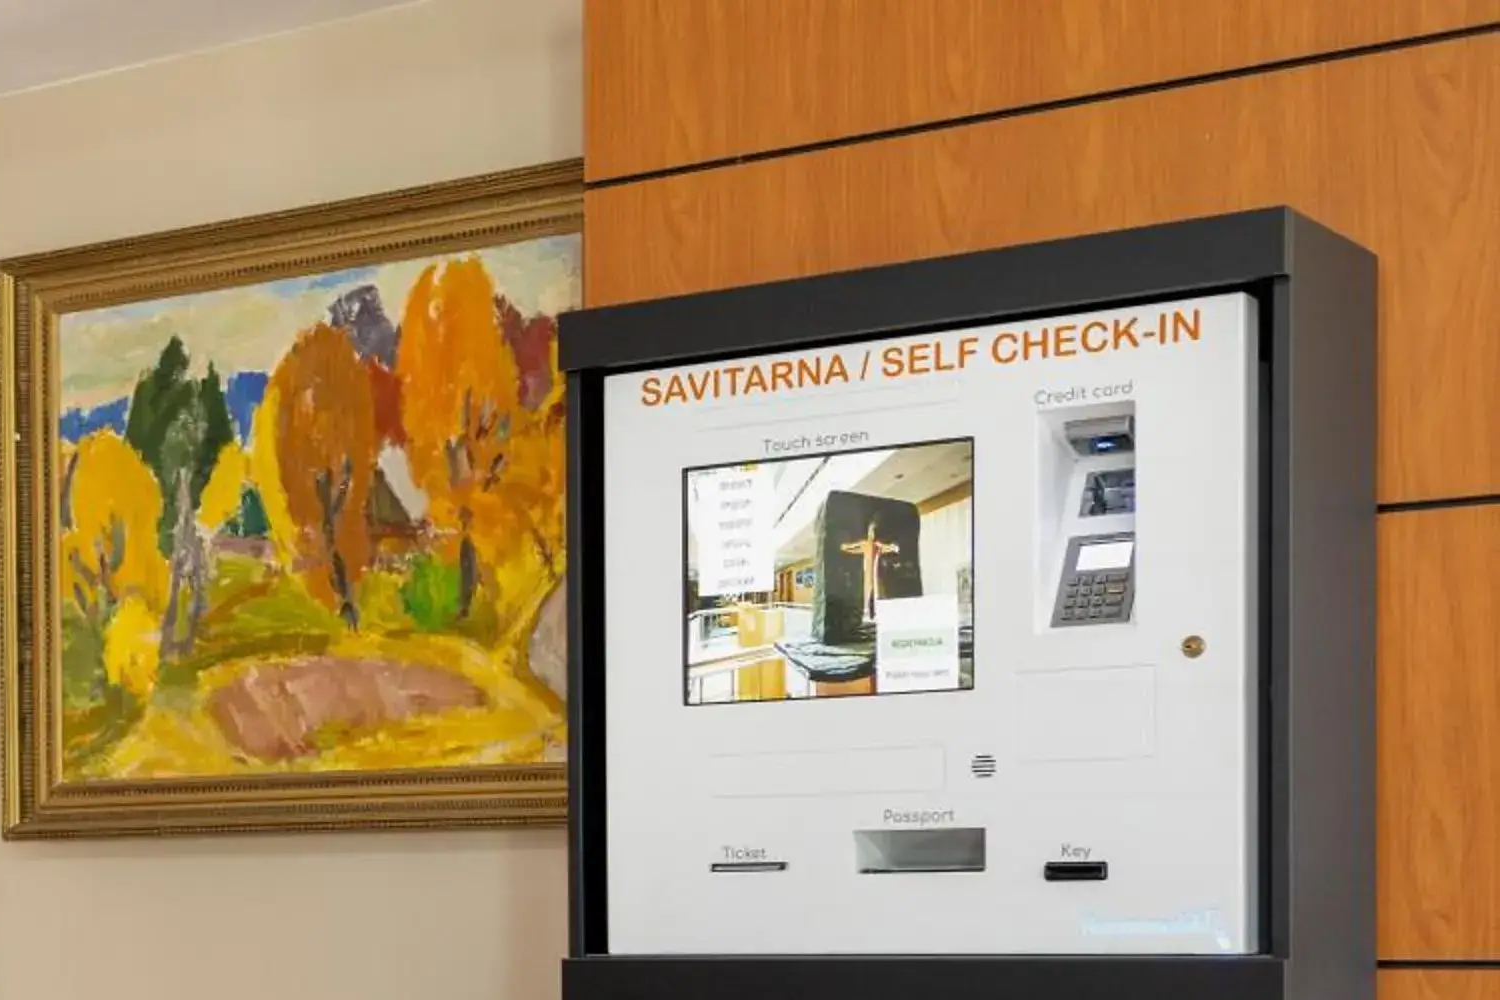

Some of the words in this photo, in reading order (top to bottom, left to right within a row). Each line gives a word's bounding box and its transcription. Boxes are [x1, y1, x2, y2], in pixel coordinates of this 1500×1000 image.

[641, 354, 849, 407] SAVITARNA
[859, 350, 871, 381] /
[881, 337, 979, 378] SELF
[991, 308, 1201, 365] CHECK-IN
[1034, 386, 1087, 405] Credit
[1092, 379, 1134, 399] card
[761, 435, 811, 454] Touch
[815, 430, 869, 447] screen
[883, 808, 955, 827] Passport
[722, 845, 768, 860] Ticket
[1061, 843, 1092, 861] Key
